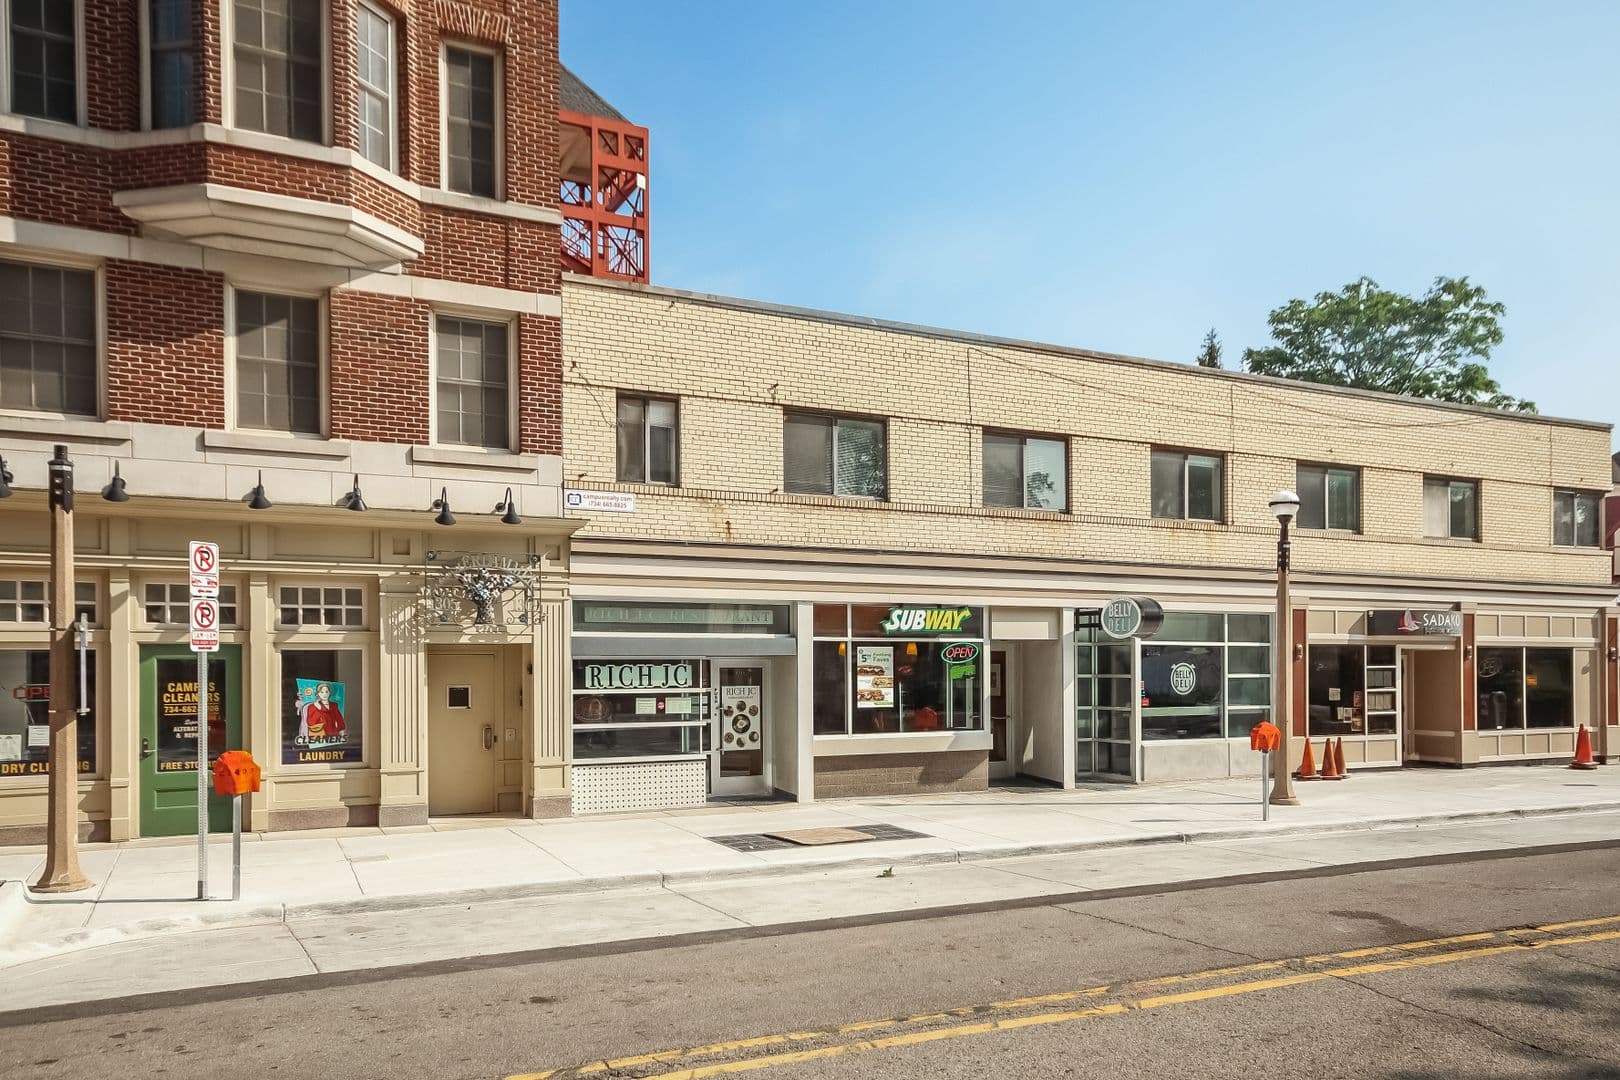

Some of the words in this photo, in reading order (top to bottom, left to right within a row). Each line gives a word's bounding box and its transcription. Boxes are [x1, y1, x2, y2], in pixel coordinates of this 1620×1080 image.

[1108, 602, 1132, 617] BELLY
[884, 608, 972, 632] SUBWAY
[1108, 618, 1131, 632] DELI
[1423, 613, 1461, 627] SADAKO
[946, 646, 974, 658] OPEN
[589, 664, 653, 688] RICH
[661, 664, 688, 688] JC
[1175, 669, 1191, 679] BELLY
[167, 682, 216, 692] CAMPS
[1175, 679, 1190, 688] DELI
[727, 687, 746, 696] RICH
[747, 687, 757, 696] JC
[163, 692, 221, 703] CLEANRS
[296, 735, 348, 745] CLEANERS
[299, 751, 345, 761] LAUNDRY
[1, 763, 26, 773] DRY
[160, 761, 183, 770] FREE
